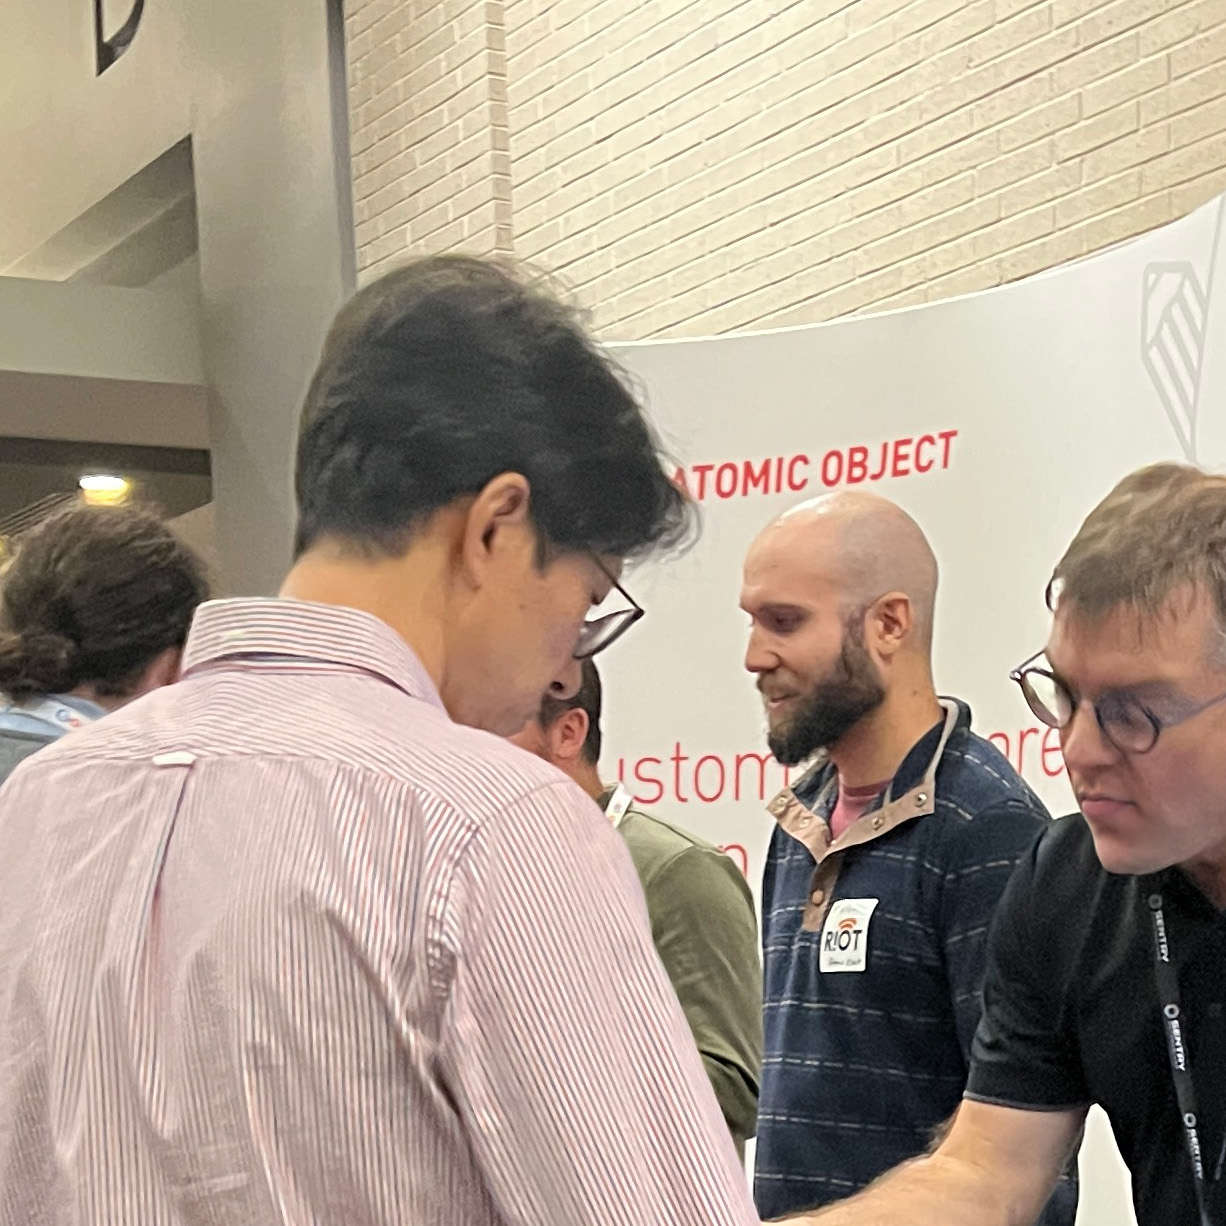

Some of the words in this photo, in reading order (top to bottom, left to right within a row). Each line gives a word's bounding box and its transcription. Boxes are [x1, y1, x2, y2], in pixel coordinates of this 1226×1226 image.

[672, 453, 809, 501] ATOMIC
[820, 429, 958, 487] OBJECT
[1171, 1019, 1186, 1072] SENTRY
